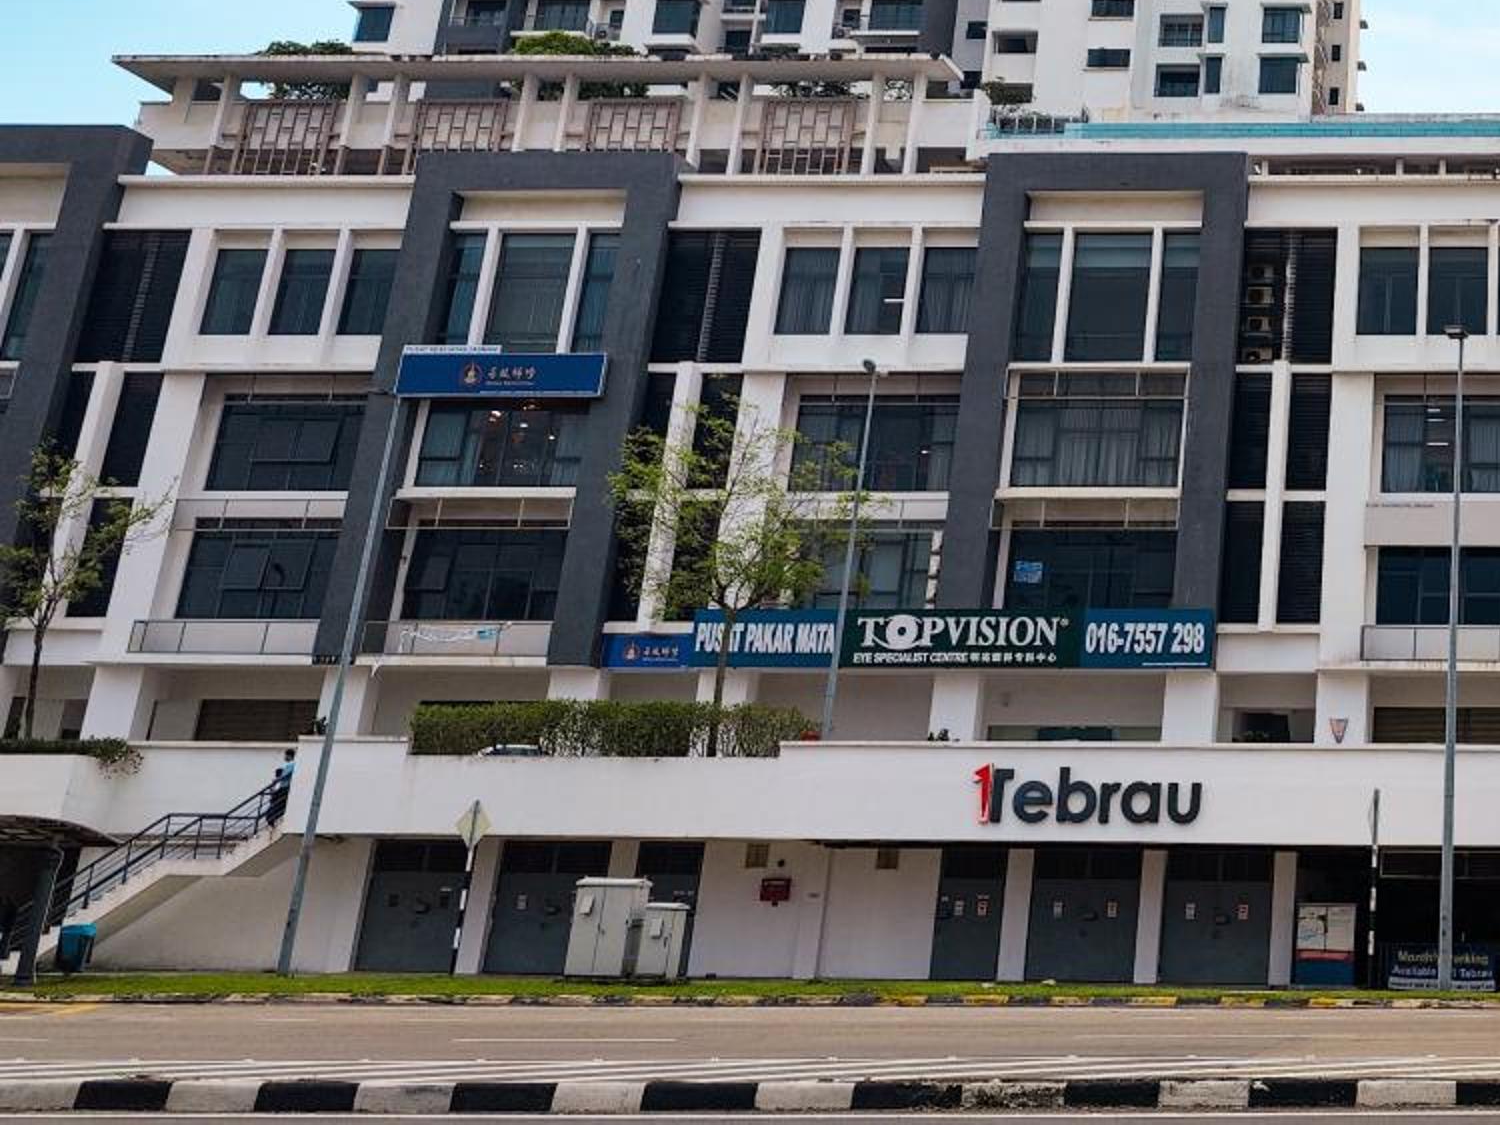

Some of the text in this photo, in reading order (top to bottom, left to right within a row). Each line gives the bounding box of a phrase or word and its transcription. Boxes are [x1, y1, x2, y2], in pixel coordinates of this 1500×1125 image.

[744, 623, 794, 654] PAKAR
[795, 623, 835, 654] MATA
[1085, 622, 1205, 654] 016-7557 298
[853, 652, 968, 664] EYE SPECIALIST CENTRE
